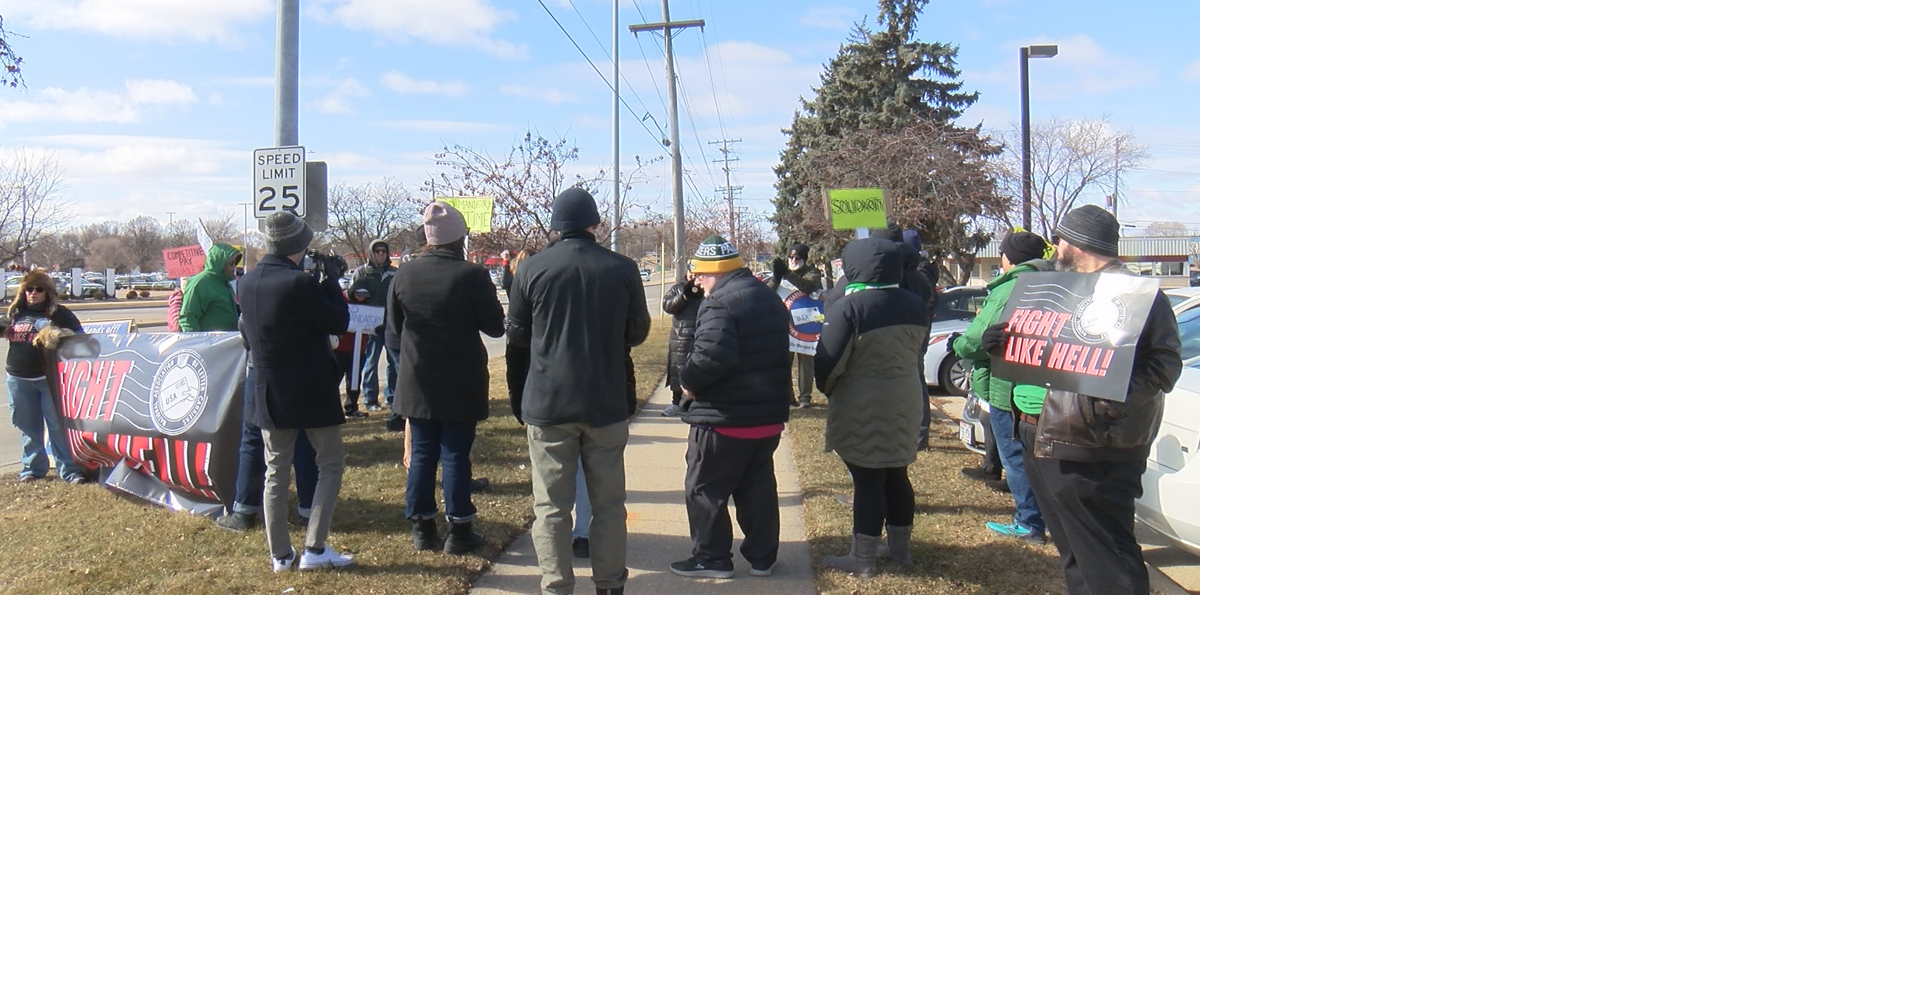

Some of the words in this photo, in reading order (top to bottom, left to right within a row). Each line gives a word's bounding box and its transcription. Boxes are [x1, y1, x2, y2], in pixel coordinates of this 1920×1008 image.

[258, 153, 301, 166] SPEED
[262, 168, 296, 180] LIMIT
[258, 185, 300, 212] 25
[178, 257, 192, 267] PAY
[1005, 308, 1072, 338] FIGHT
[1005, 336, 1047, 366] LIKE
[1047, 342, 1114, 377] HELL!
